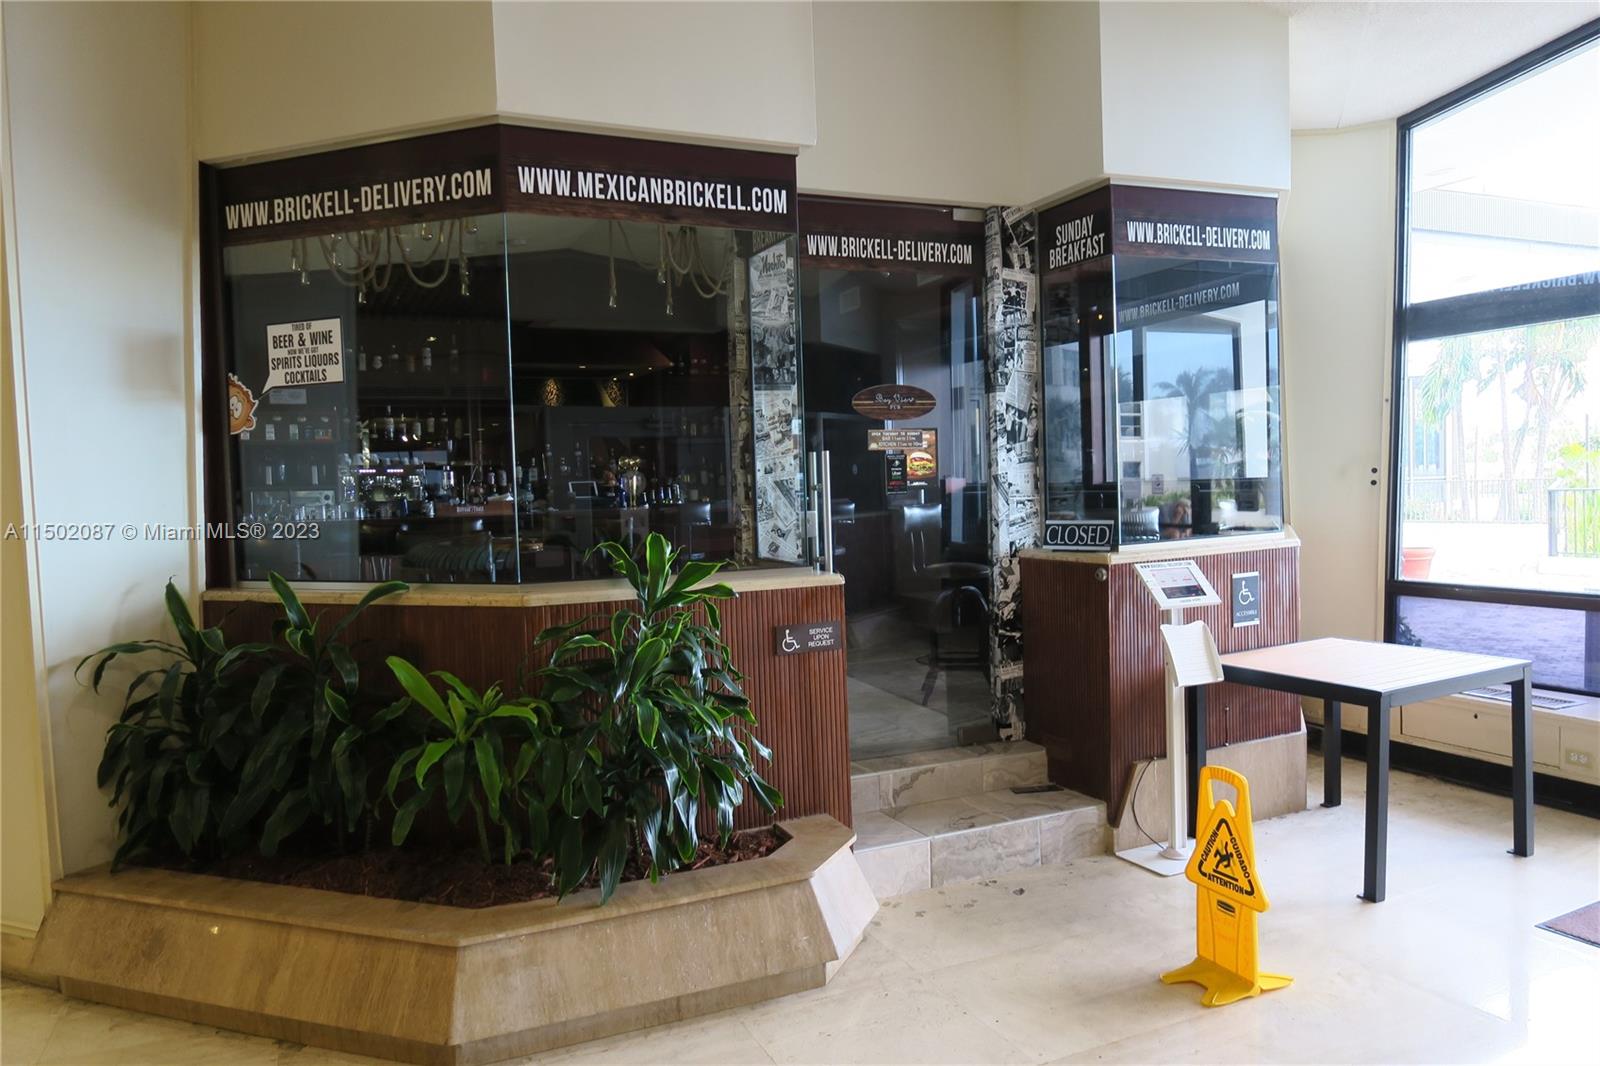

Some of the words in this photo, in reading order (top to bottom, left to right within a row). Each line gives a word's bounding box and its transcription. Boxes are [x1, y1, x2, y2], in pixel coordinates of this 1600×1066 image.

[225, 168, 492, 230] WWW.BRICKELL-DELIVERY.COM
[518, 166, 787, 214] WWW.MEXICANBRICKELL.COM
[1055, 214, 1094, 246] SUNDAY
[1127, 220, 1271, 251] WWW.BRICKELL-DELIVERY.COM
[806, 234, 973, 265] WWW.BRICKELL-DELIVERY.COM
[1049, 233, 1105, 270] BREAKFAST
[306, 322, 312, 330] OF
[272, 334, 294, 350] BEER
[298, 332, 306, 346] &
[309, 330, 334, 346] WINE
[271, 355, 302, 371] SPIRITS
[304, 352, 340, 368] LIQUORS
[284, 368, 328, 384] COCKTAILS
[1046, 524, 1111, 546] CLOSED
[808, 639, 834, 647] REQUEST
[809, 627, 832, 635] SERVICE
[1201, 829, 1219, 861] CAUTION
[1229, 836, 1250, 880] CUIDADO
[1207, 872, 1245, 895] ATTENTION
